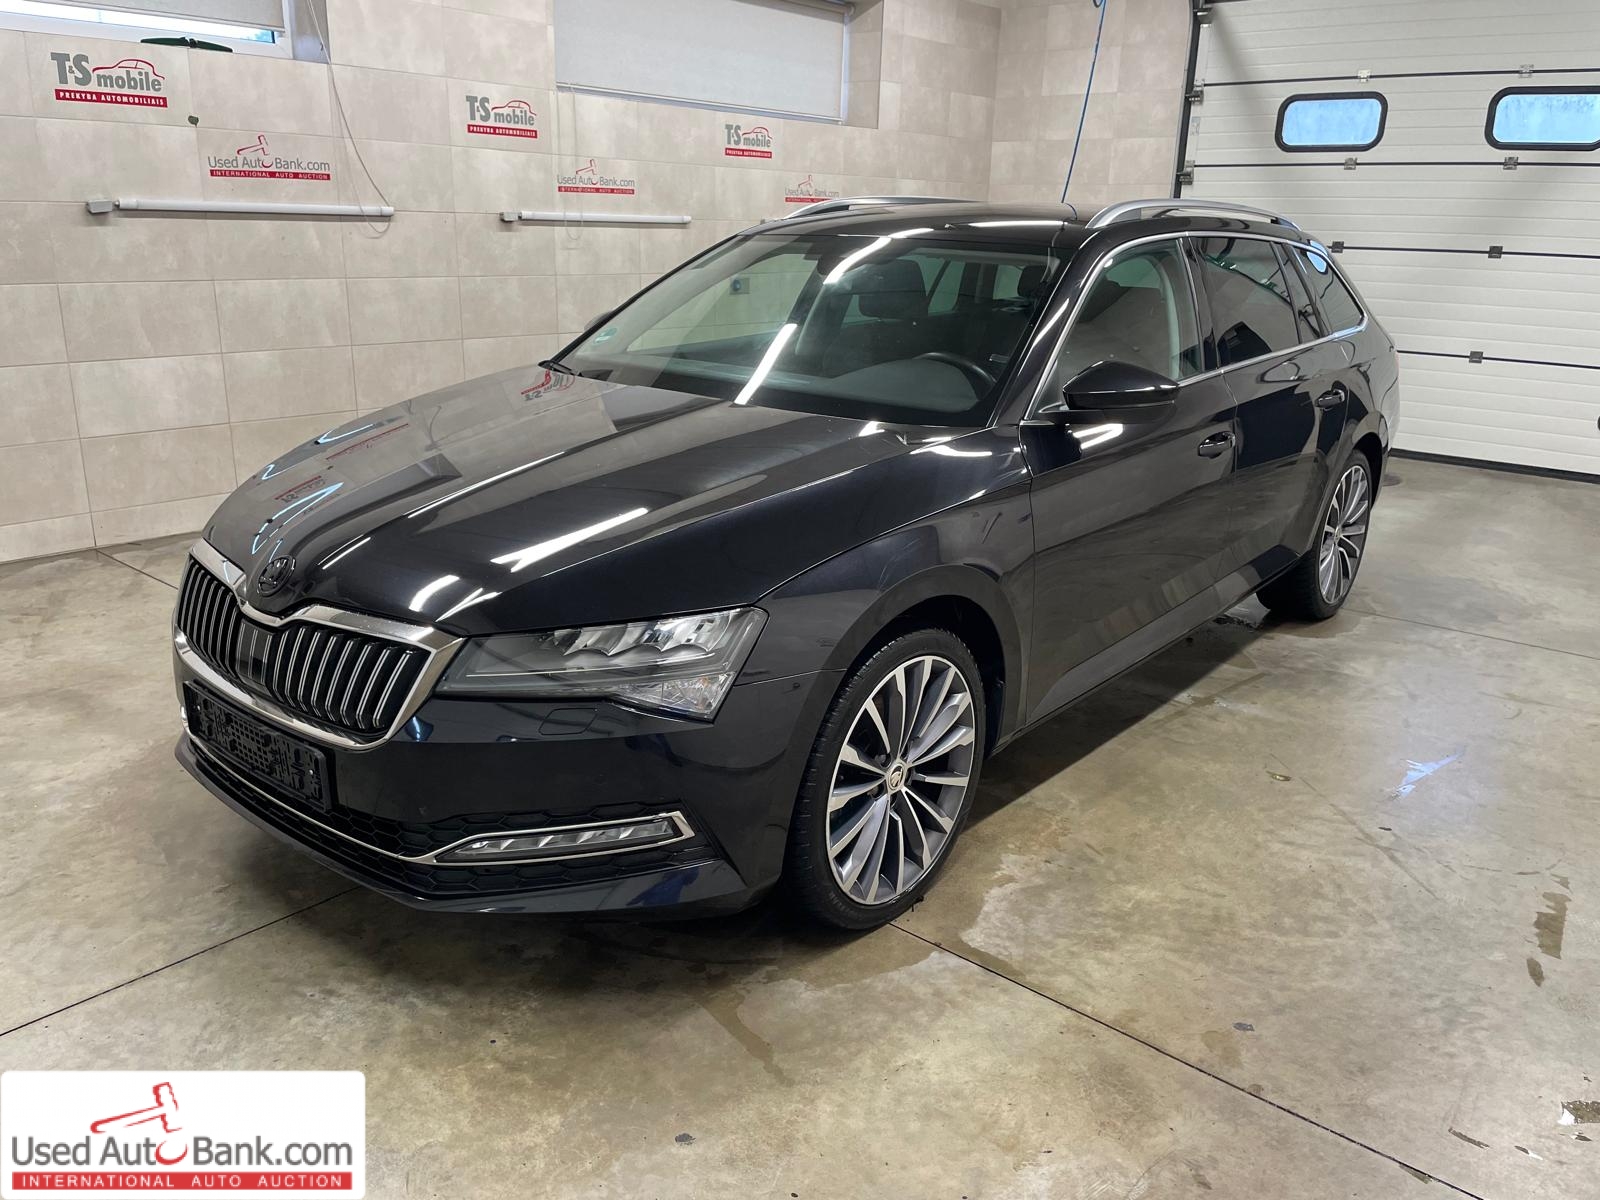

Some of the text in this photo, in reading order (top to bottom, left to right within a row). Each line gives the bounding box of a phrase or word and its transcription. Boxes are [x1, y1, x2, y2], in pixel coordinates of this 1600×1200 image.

[96, 70, 162, 92] mobile
[60, 91, 165, 105] PREKYBA AUTOMOBILIAIS
[494, 109, 535, 126] mobile
[743, 134, 771, 148] mobile
[207, 156, 239, 169] Used
[275, 158, 330, 171] Bank.com
[213, 170, 270, 178] INTERNATIONAL
[557, 175, 577, 185] Used
[599, 177, 635, 187] Bank.com
